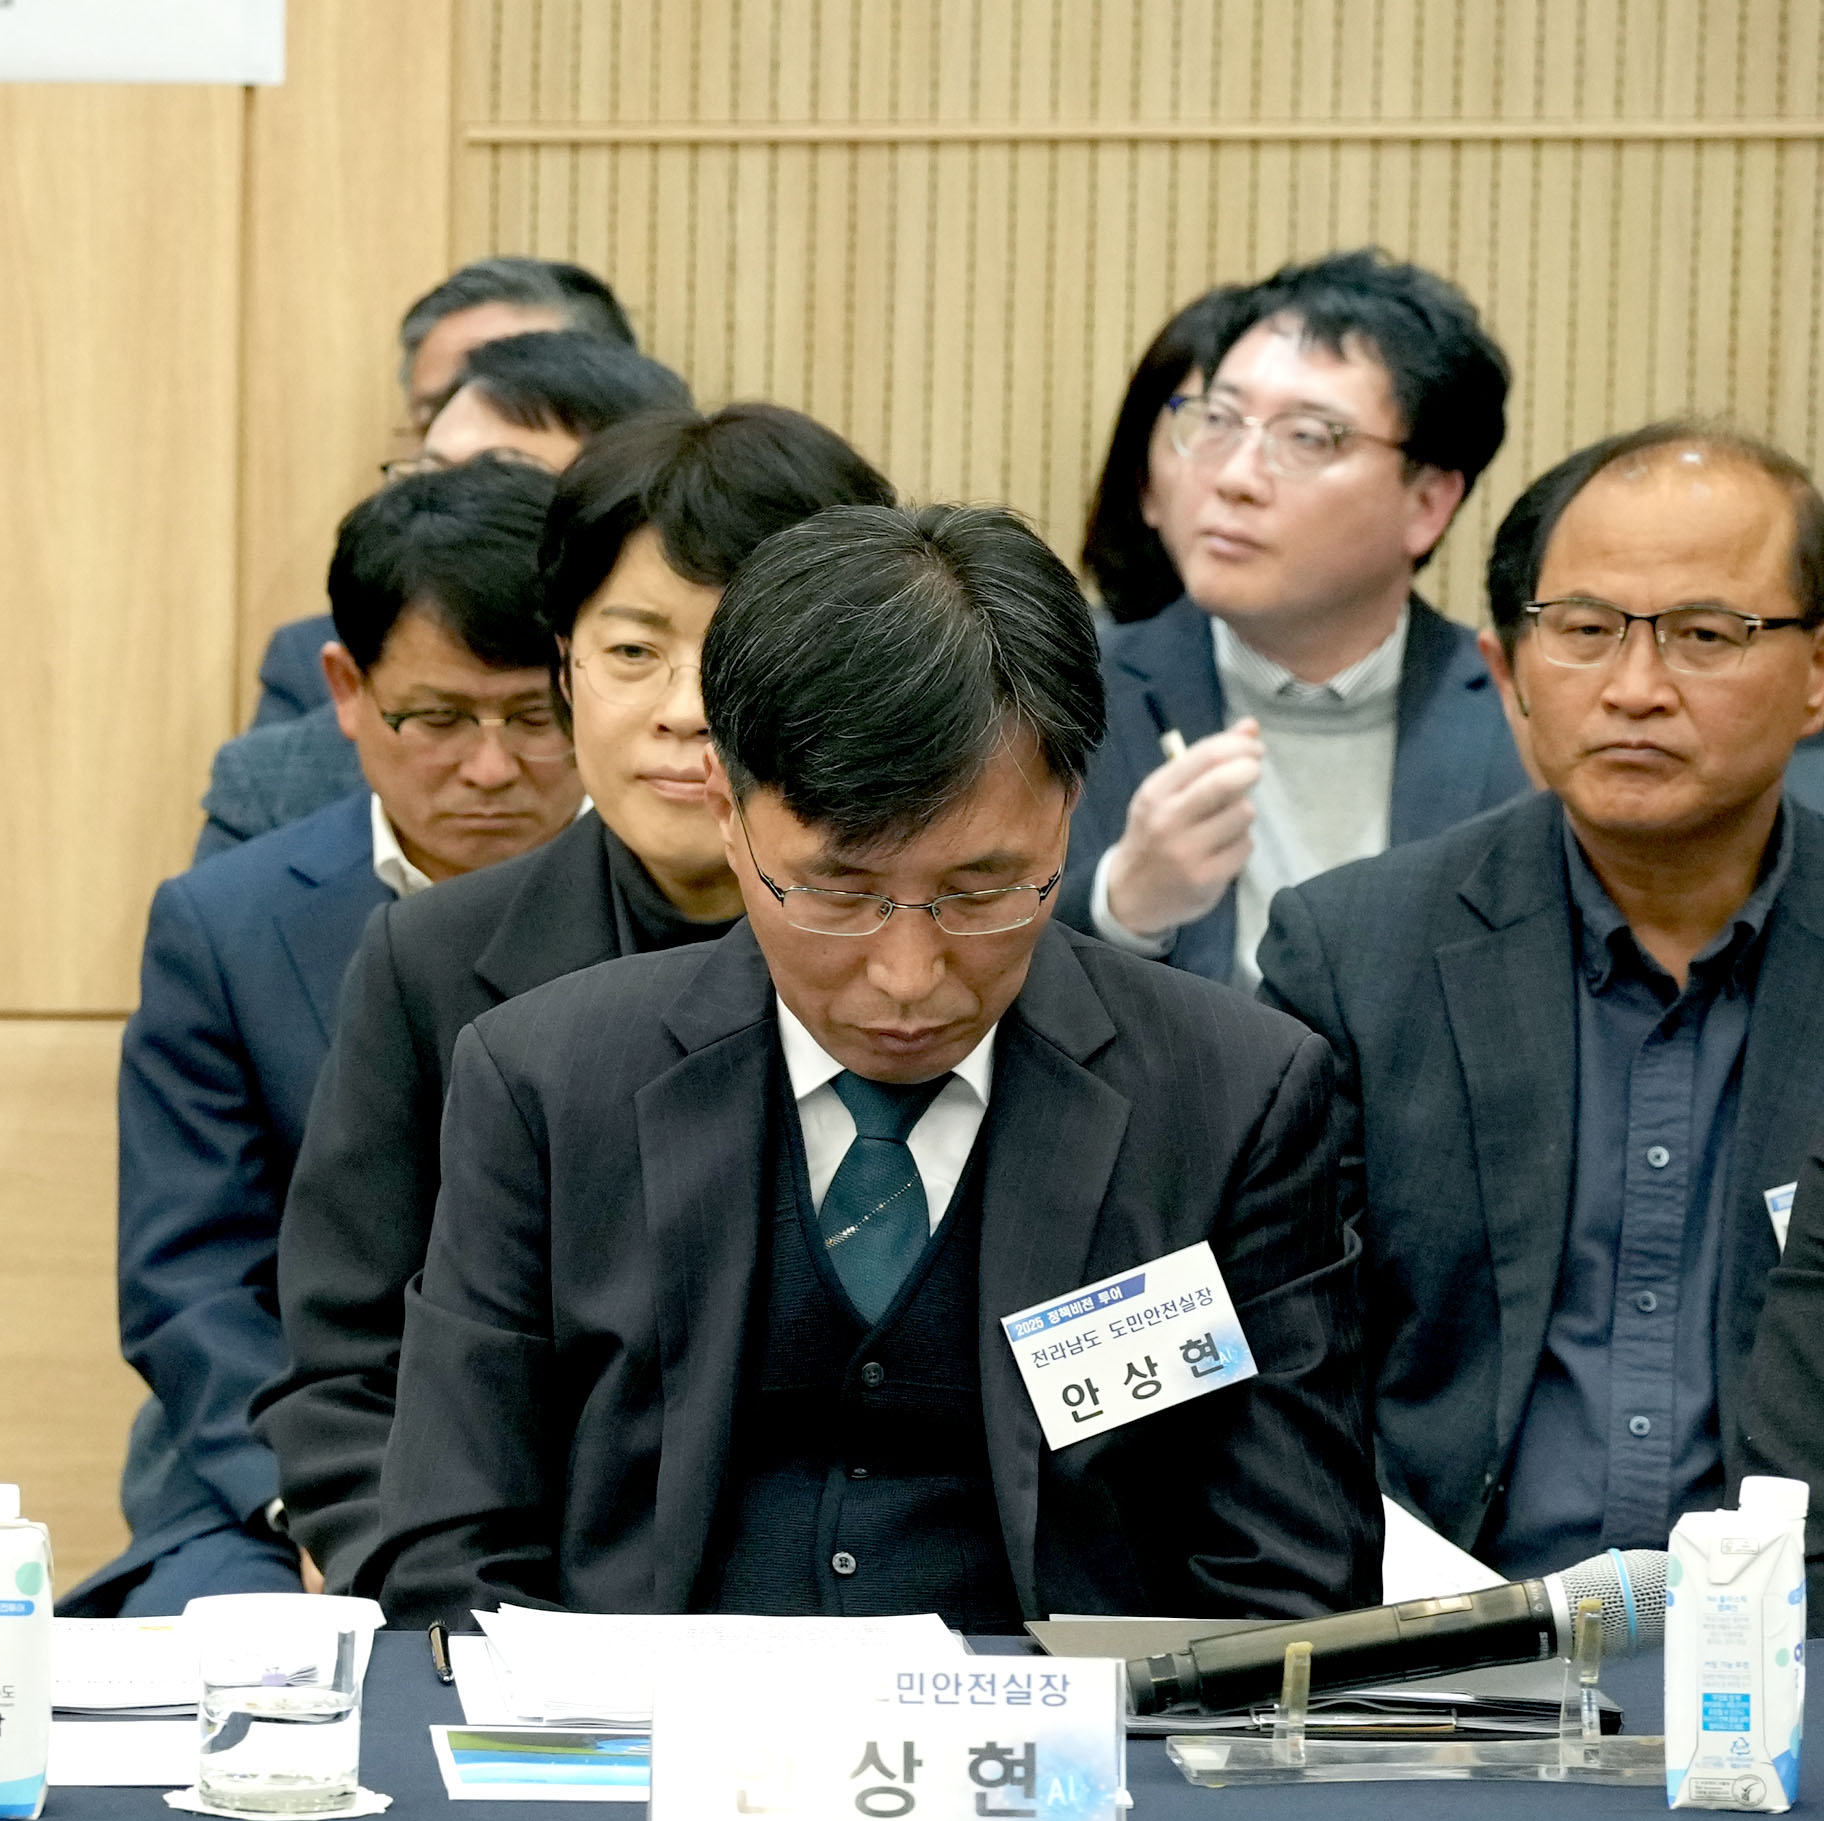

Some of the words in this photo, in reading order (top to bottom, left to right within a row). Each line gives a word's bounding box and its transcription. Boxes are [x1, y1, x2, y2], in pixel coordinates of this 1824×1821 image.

[1014, 1315, 1045, 1338] 2025
[1047, 1297, 1095, 1325] 정책비전
[1098, 1286, 1125, 1307] 투어
[1031, 1329, 1101, 1369] 전라남도
[1108, 1286, 1215, 1341] 도민안전실장
[876, 1671, 1072, 1708] 민안전실장
[1047, 1775, 1078, 1807] AI
